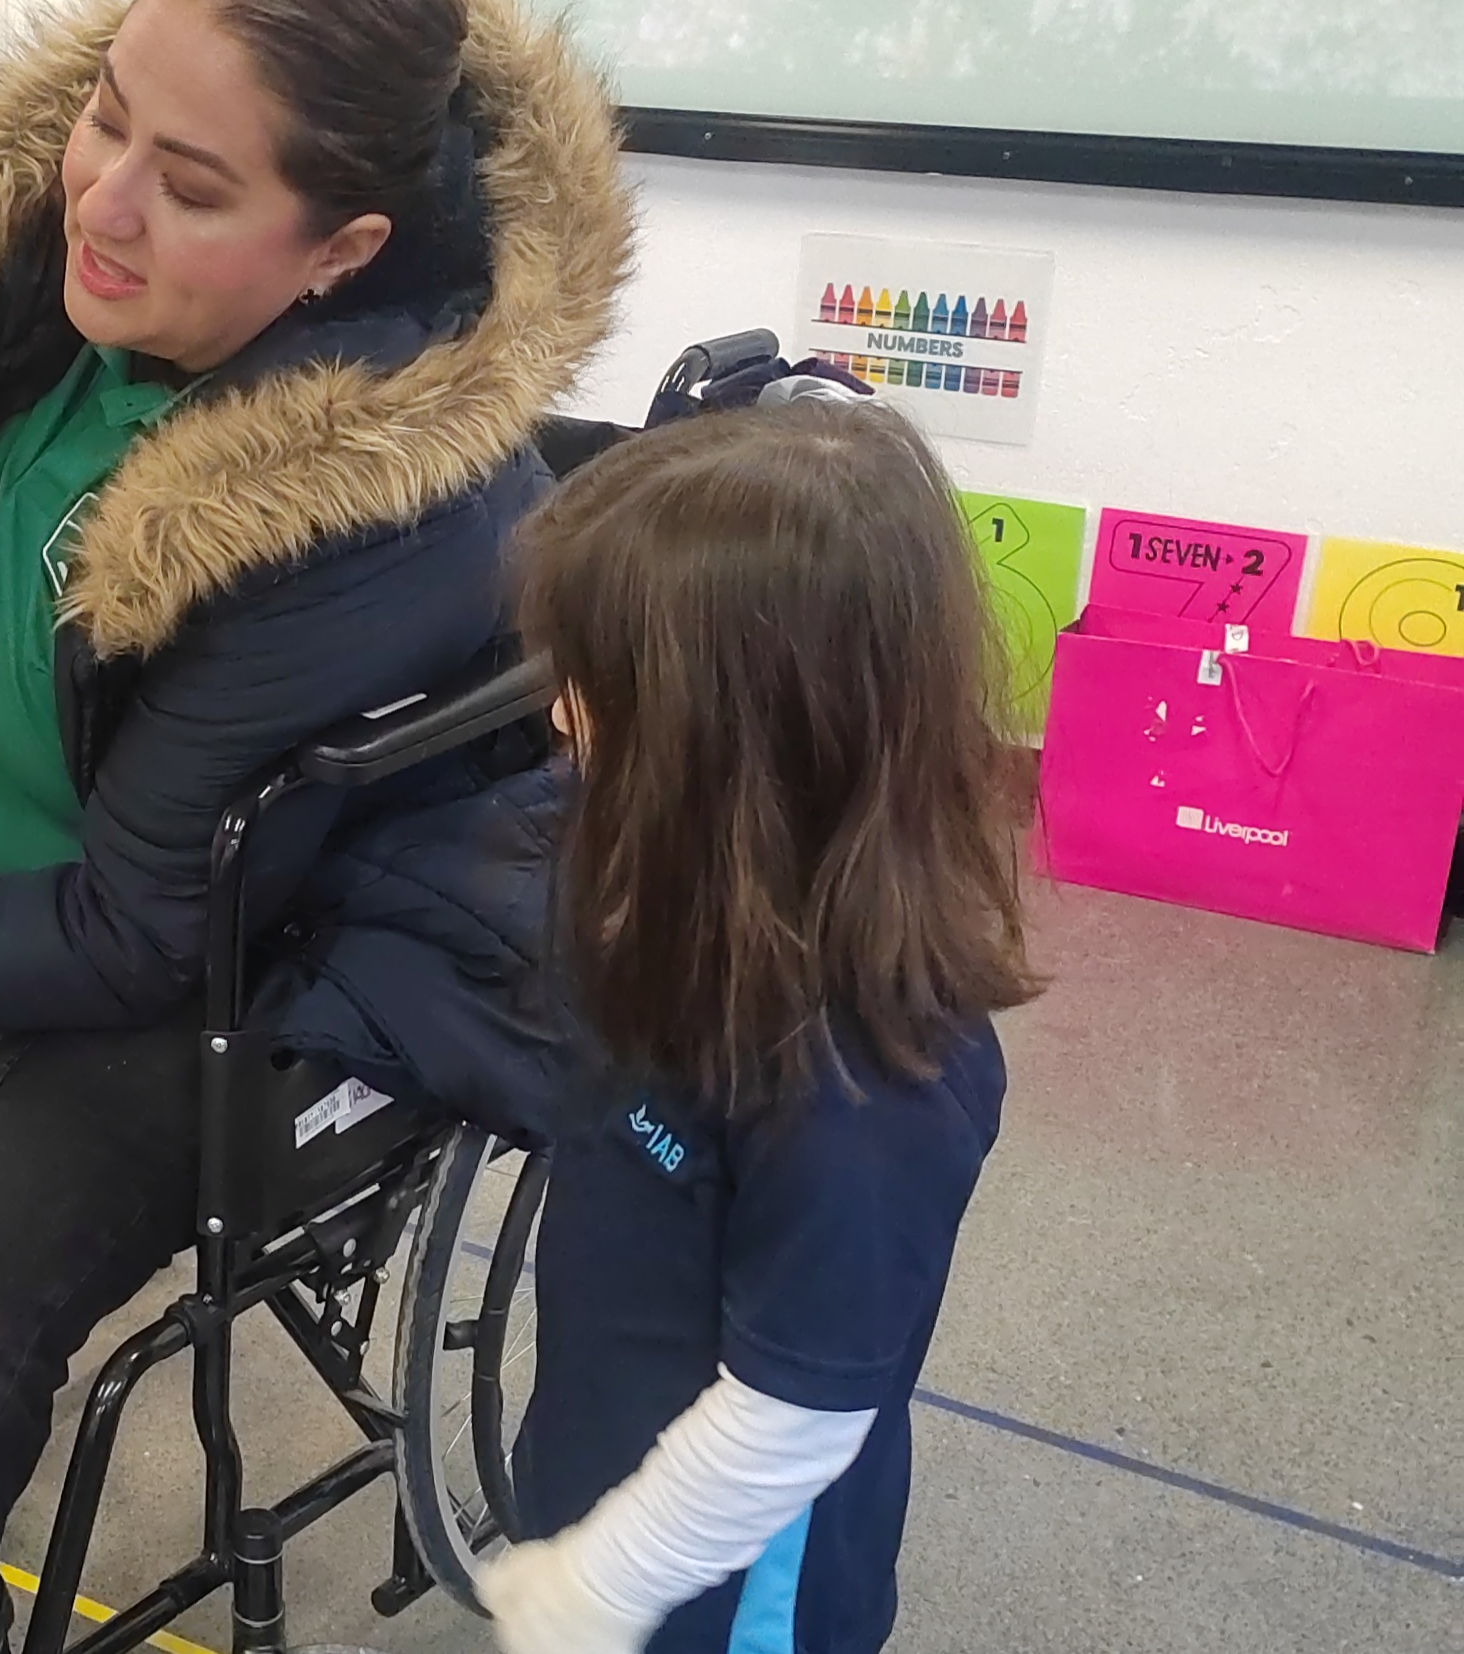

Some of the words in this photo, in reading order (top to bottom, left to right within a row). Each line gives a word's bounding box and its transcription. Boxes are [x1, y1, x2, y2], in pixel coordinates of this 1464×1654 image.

[867, 333, 964, 358] NUMBERS
[991, 518, 1004, 543] 1
[1129, 533, 1142, 559] 1
[1145, 537, 1222, 572] SEVEN
[1241, 550, 1265, 576] 2
[1204, 815, 1289, 847] Liverpool
[645, 1123, 685, 1173] IAB
